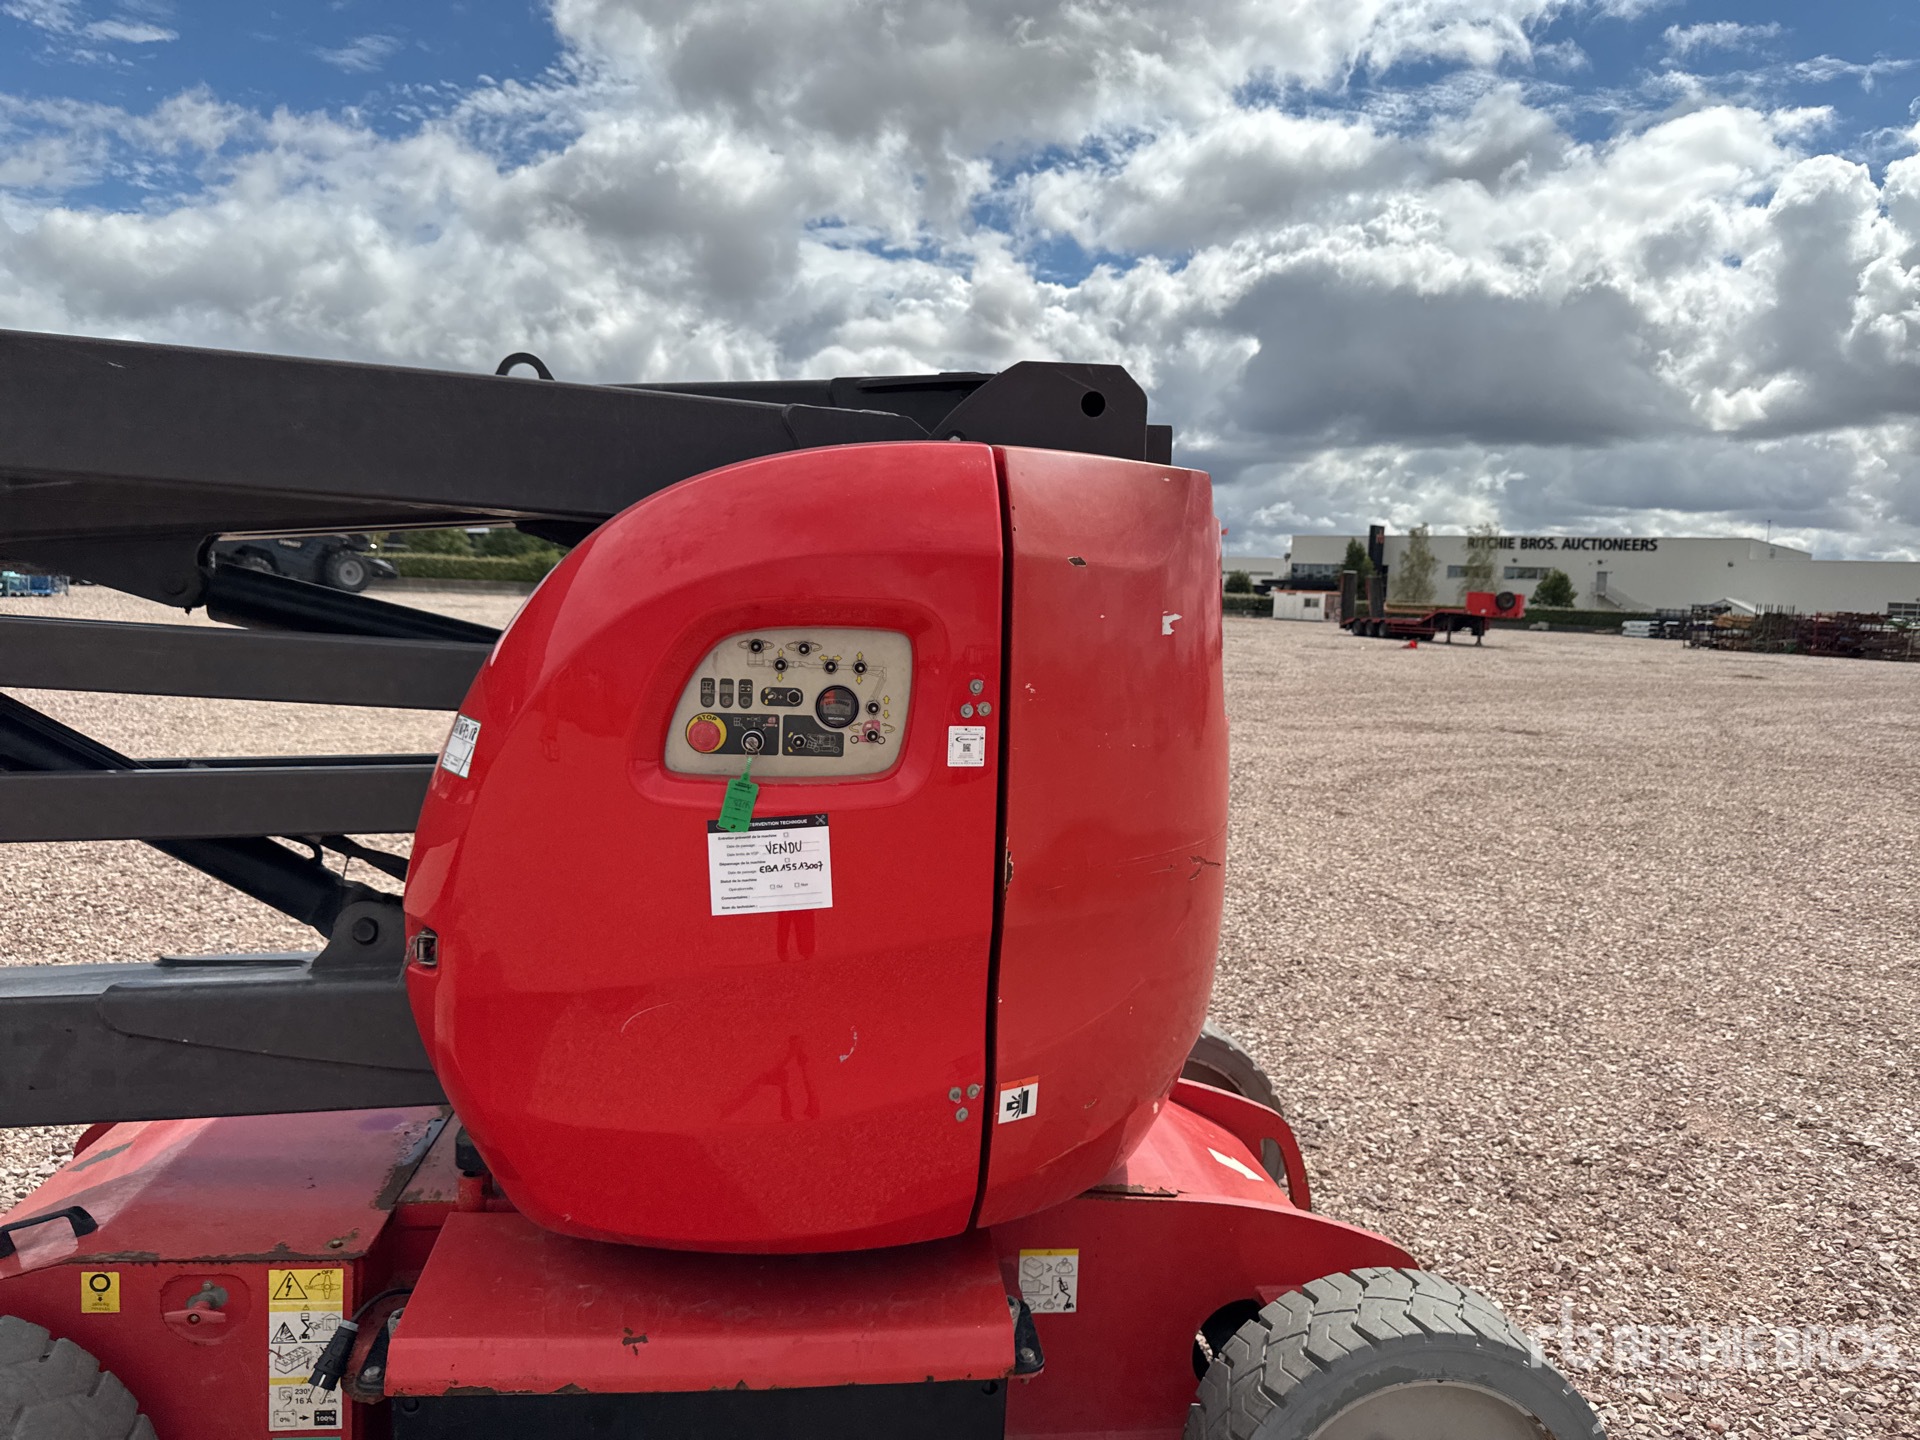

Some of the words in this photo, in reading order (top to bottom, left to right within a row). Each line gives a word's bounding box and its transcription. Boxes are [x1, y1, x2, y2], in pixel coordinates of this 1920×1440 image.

[1467, 537, 1515, 550] RITCHIE
[1520, 538, 1557, 550] BROS.
[1562, 538, 1658, 551] AUCTIONEERS
[765, 840, 802, 855] VENDU
